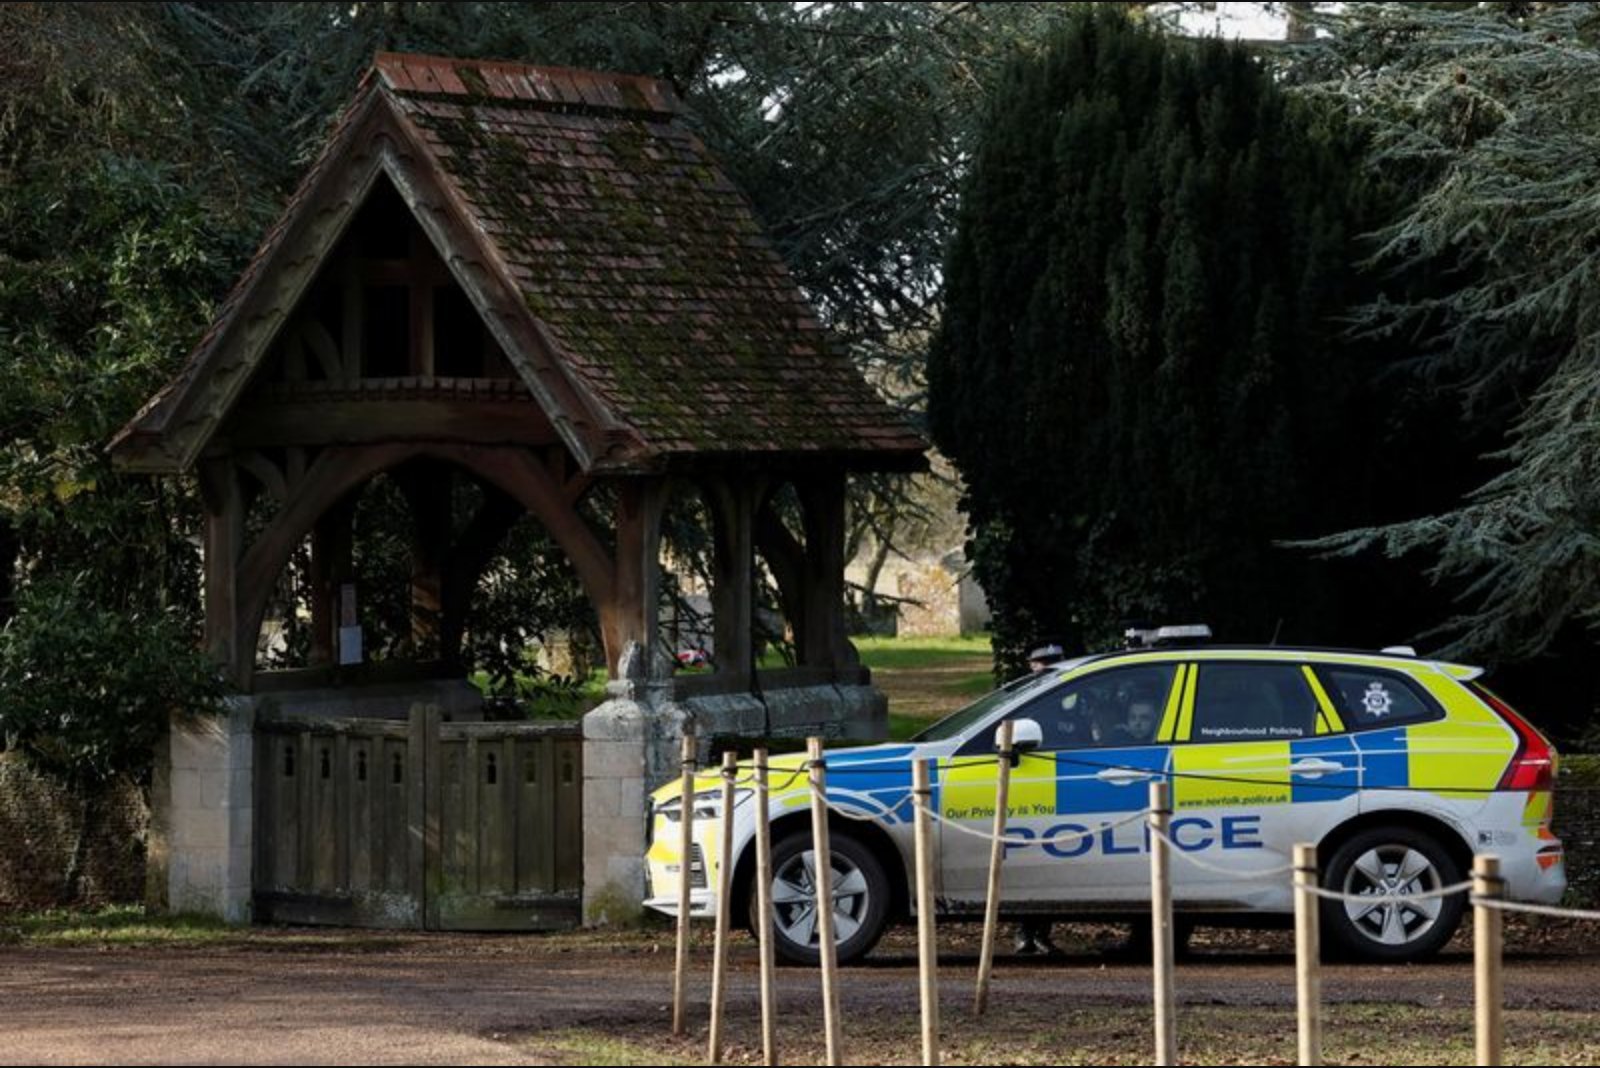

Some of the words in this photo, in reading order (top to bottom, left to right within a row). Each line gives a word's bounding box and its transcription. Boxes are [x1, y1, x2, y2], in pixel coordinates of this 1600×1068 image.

[1201, 727, 1266, 737] Neighbourhood
[1269, 726, 1303, 737] Policing
[1178, 794, 1288, 807] www.norfolk.police.uk
[945, 807, 967, 819] Our
[971, 806, 1015, 818] Prioy
[1017, 805, 1028, 814] is
[1031, 803, 1056, 814] You
[1001, 815, 1264, 860] POLICE
